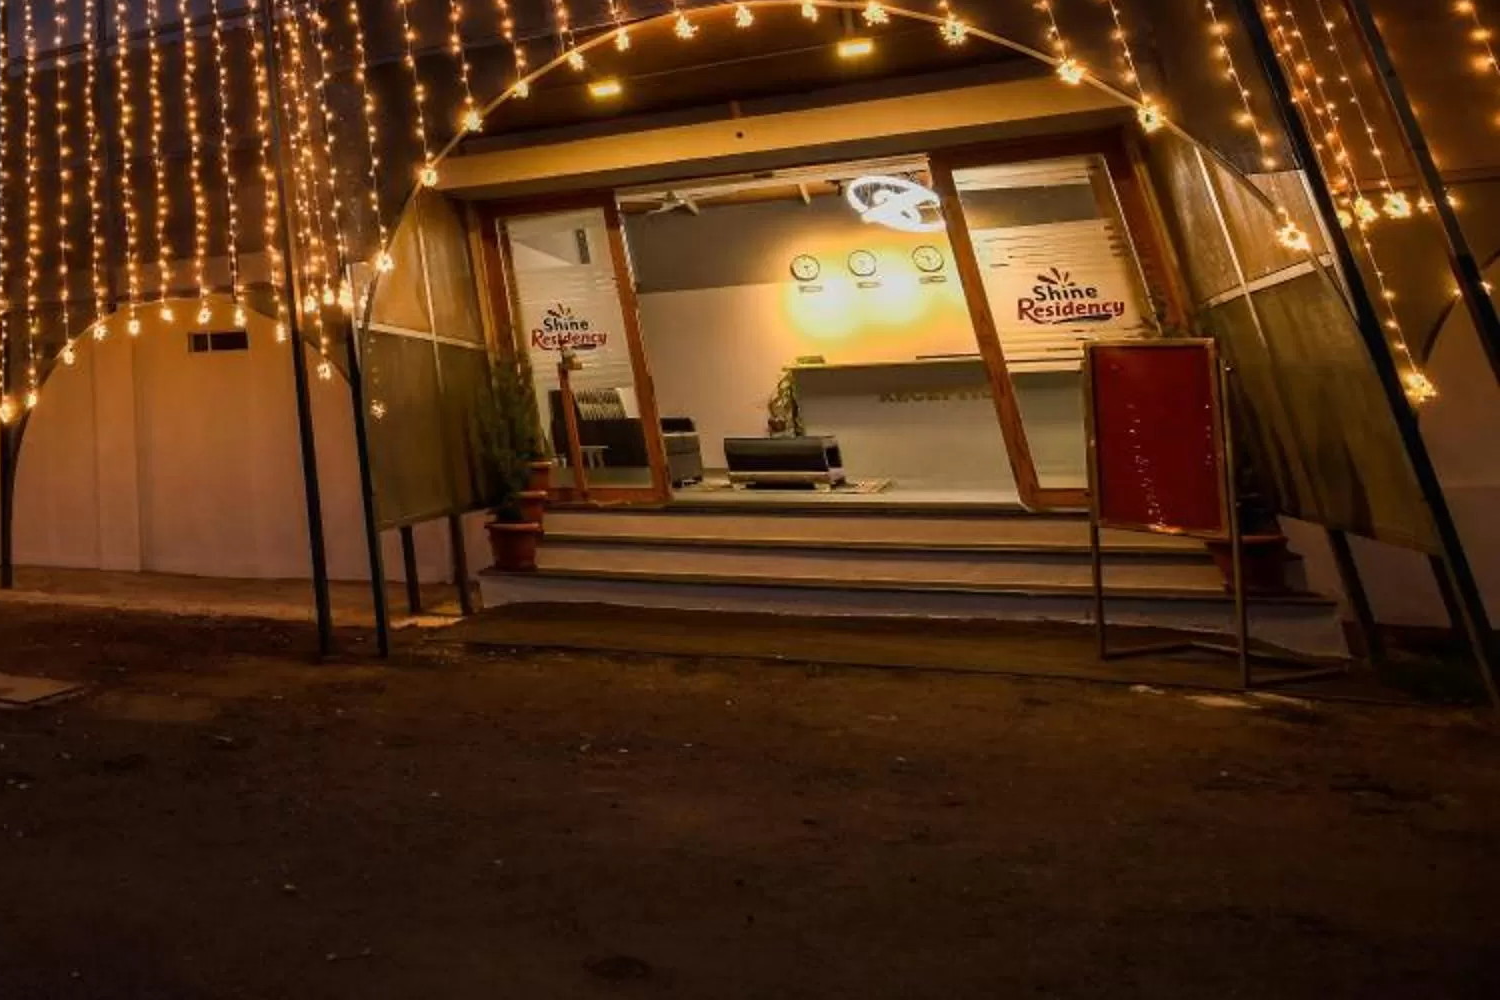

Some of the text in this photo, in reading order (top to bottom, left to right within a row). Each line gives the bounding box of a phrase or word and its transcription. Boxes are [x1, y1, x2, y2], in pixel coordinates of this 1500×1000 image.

[1033, 285, 1098, 301] Shine
[1018, 298, 1125, 324] Residency
[543, 317, 589, 332] Shine
[532, 328, 607, 350] Residency
